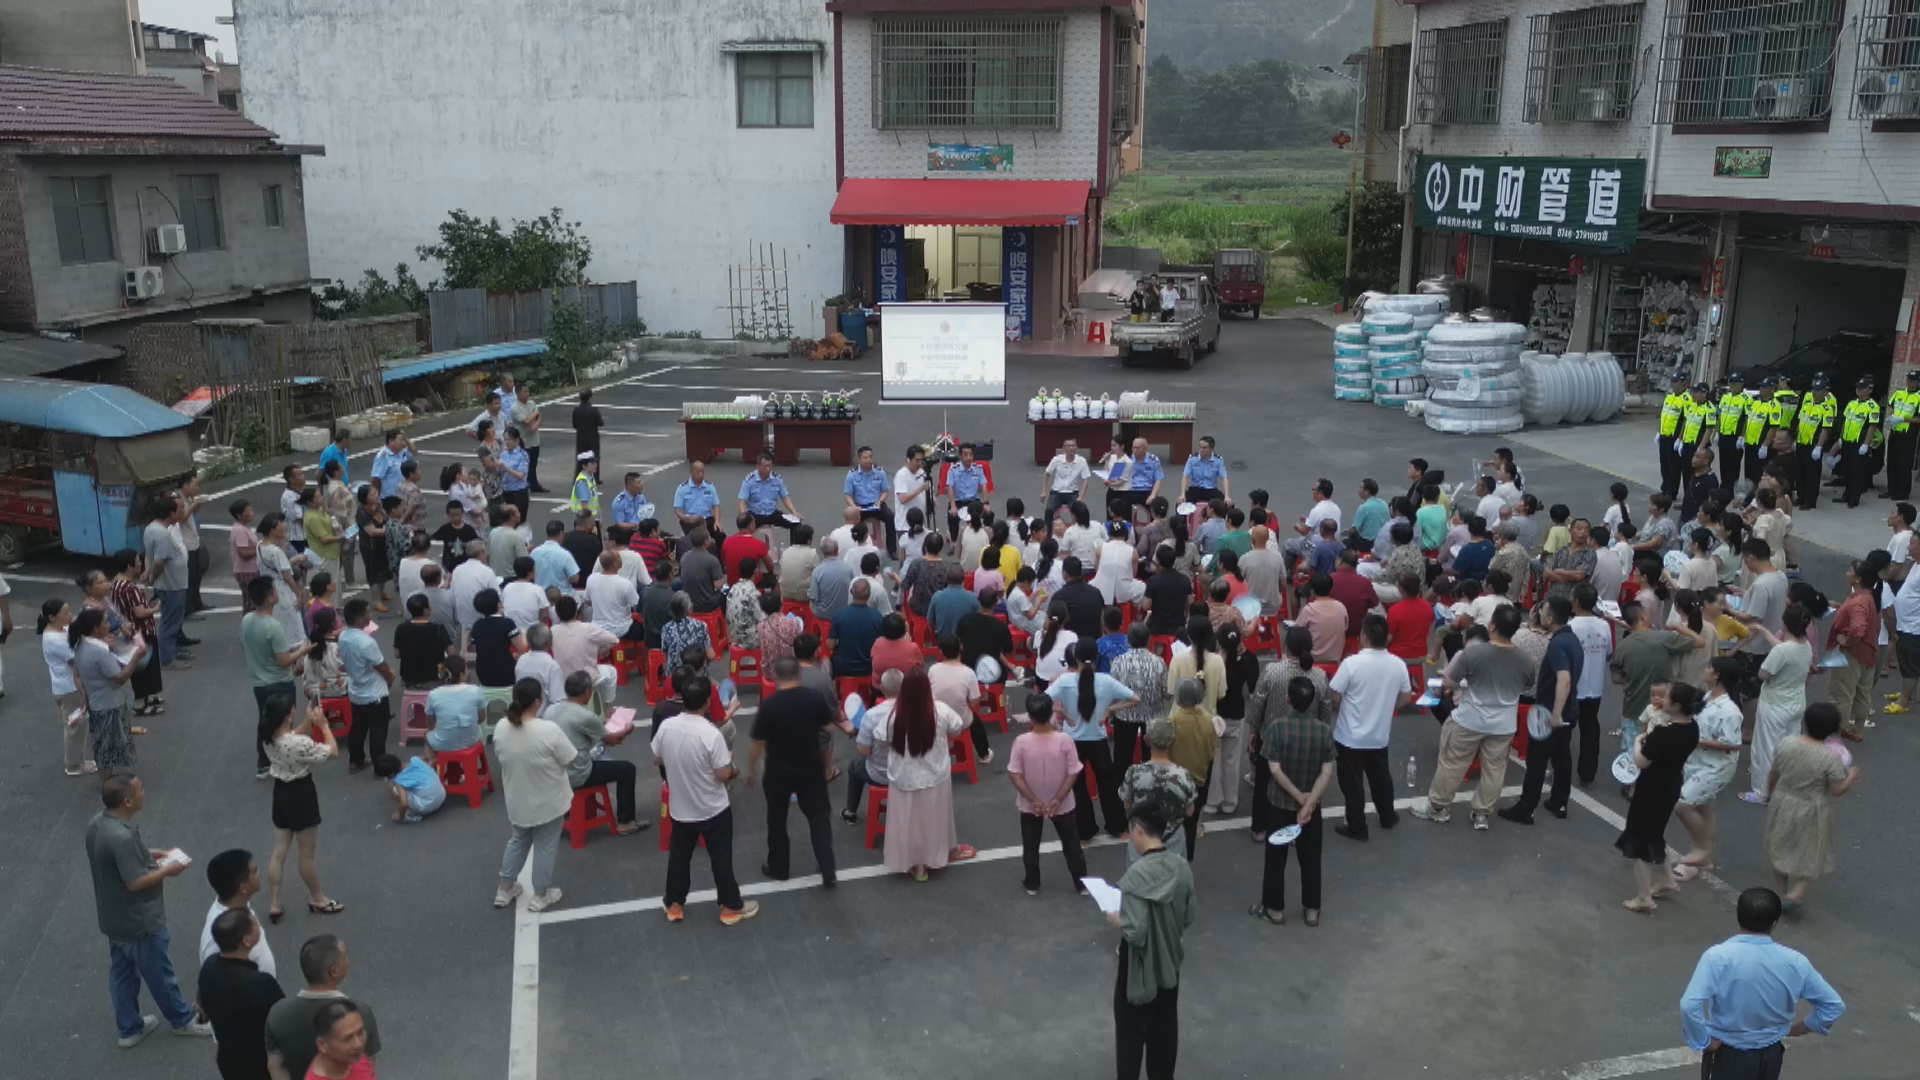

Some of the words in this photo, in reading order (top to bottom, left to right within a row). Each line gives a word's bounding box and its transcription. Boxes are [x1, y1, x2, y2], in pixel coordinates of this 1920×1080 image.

[1457, 164, 1622, 226] 中财管道
[880, 248, 898, 302] 晚安家
[1009, 251, 1027, 322] 晚安家居
